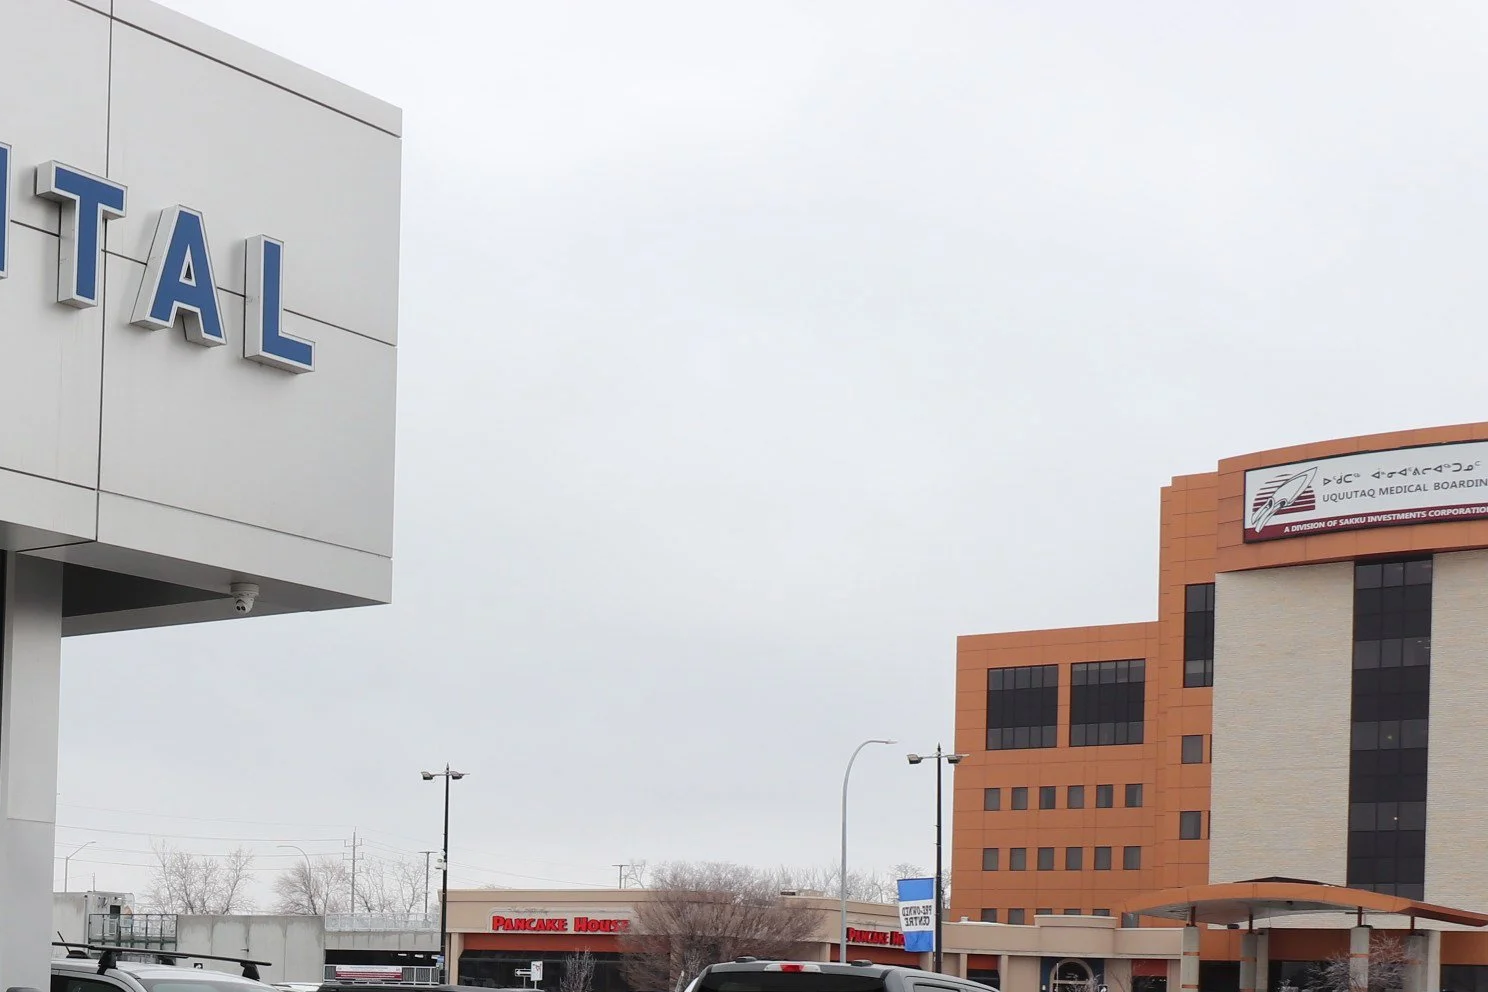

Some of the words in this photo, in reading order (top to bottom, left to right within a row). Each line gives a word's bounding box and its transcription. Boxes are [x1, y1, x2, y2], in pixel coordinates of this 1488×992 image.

[1322, 488, 1376, 503] UQUUTAQ
[1379, 482, 1429, 496] MEDICAL
[1291, 520, 1325, 533] DIVISION
[1327, 519, 1338, 528] OF
[1339, 516, 1366, 526] SAKKU
[1367, 509, 1427, 523] INVESTMENTS
[492, 916, 568, 932] PANCAKE
